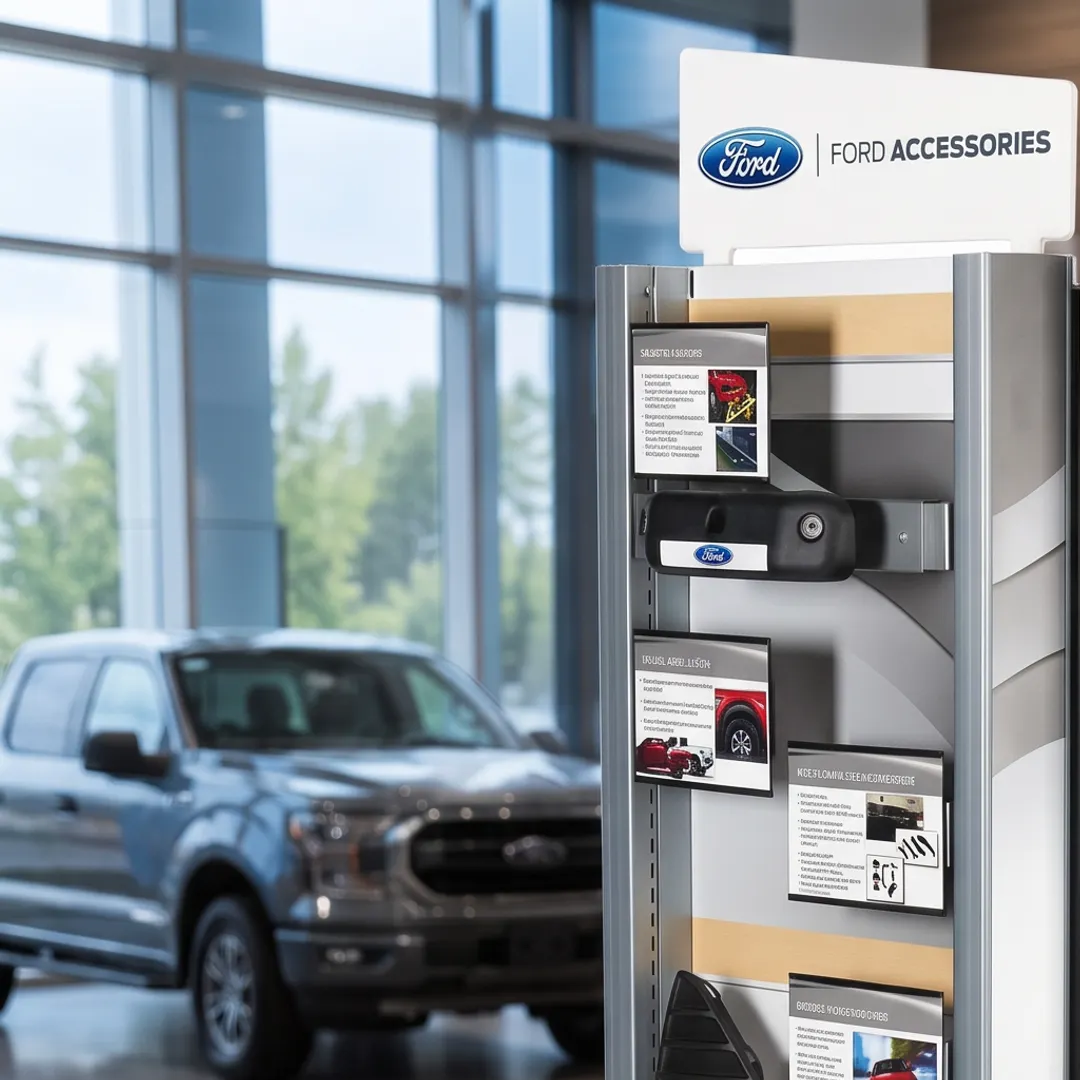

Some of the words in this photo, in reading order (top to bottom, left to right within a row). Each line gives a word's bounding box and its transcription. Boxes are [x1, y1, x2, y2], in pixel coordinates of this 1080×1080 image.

[719, 138, 782, 178] Ford
[831, 141, 886, 165] FORD
[890, 130, 1051, 162] ACCESSORIES
